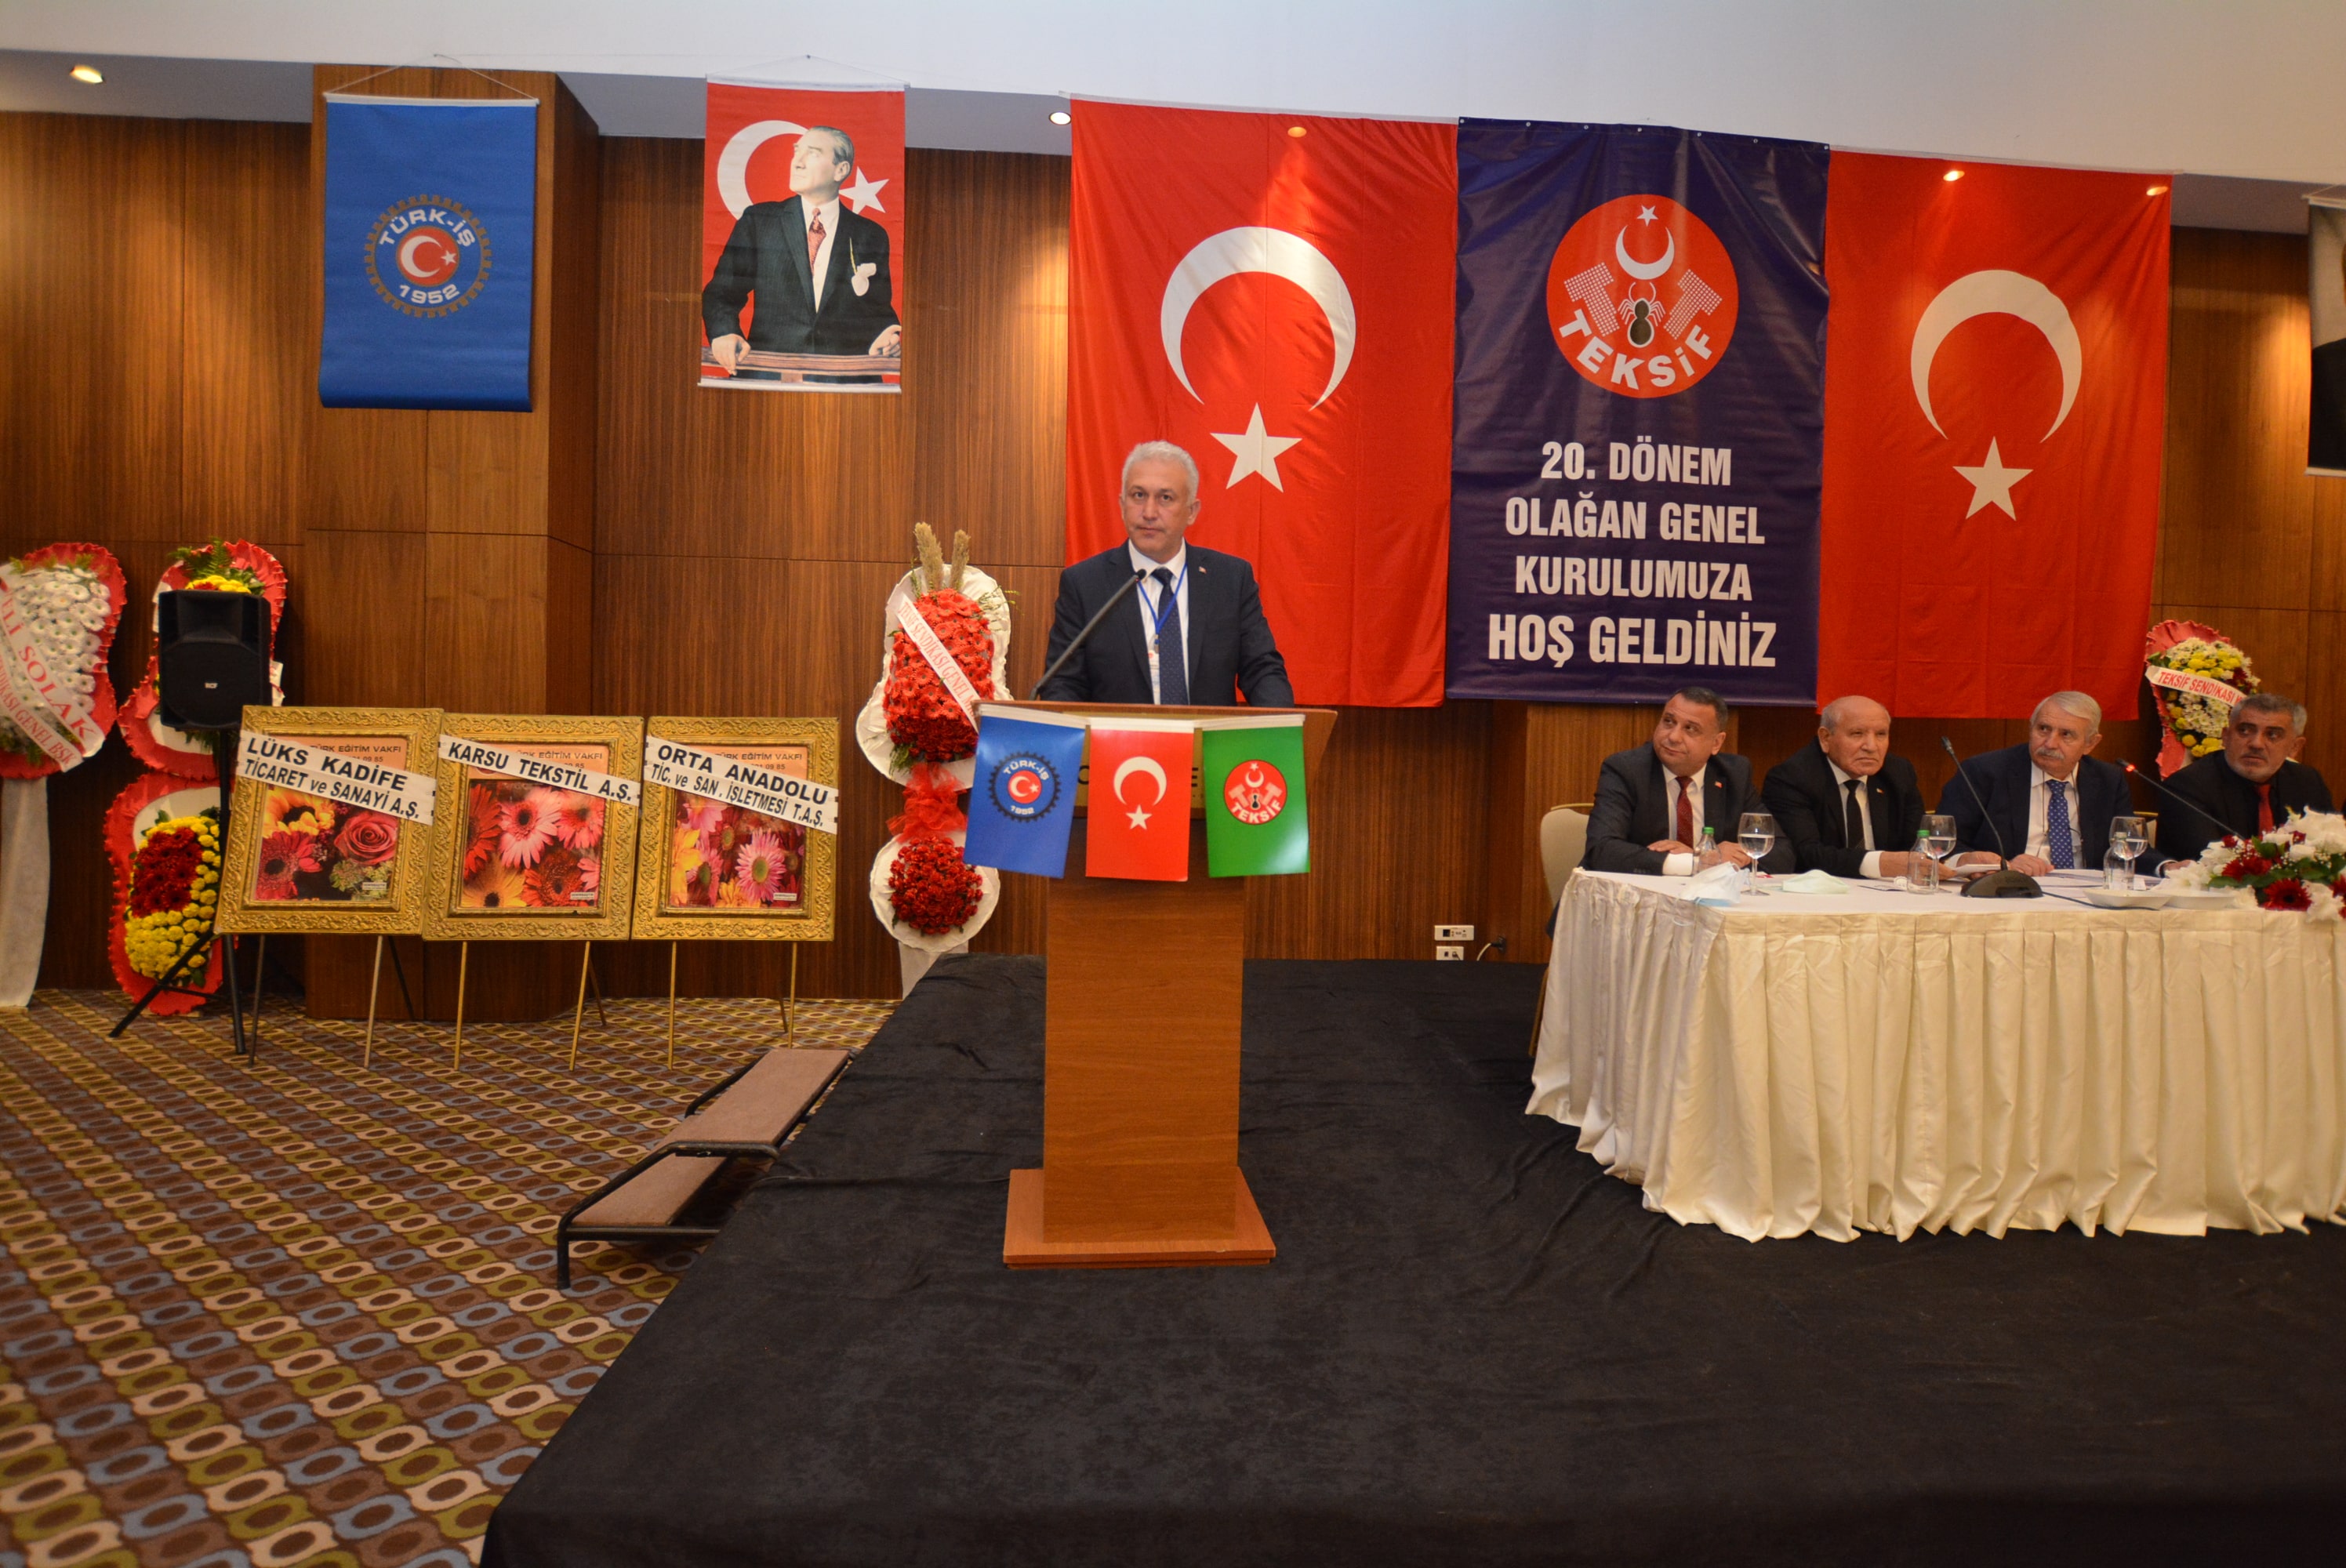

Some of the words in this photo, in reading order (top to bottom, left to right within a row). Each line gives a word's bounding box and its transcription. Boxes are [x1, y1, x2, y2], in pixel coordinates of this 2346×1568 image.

[379, 209, 476, 247] TÜRK-İŞ
[399, 283, 460, 304] 1952
[1559, 308, 1712, 390] TEKSİF
[1541, 441, 1596, 480] 20.
[1609, 435, 1731, 486] DÖNEM
[1505, 491, 1647, 539] OLAĞAN
[1659, 502, 1766, 544] GENEL
[1515, 555, 1752, 601] KURULUMUZA
[1488, 613, 1574, 668] HOŞ
[1589, 609, 1777, 667] GELDİNİZ
[19, 646, 97, 739] SOLAK
[942, 665, 970, 699] GENEL
[2158, 672, 2191, 688] TEKSİF
[2188, 678, 2235, 702] SENDİKASI
[16, 710, 53, 746] GENEL
[49, 741, 76, 765] BSK
[339, 744, 369, 753] EĞİTİM
[539, 750, 571, 759] EĞİTİM
[741, 752, 772, 760] EĞİTİM
[244, 759, 308, 789] TİCARET
[310, 779, 328, 794] ve
[330, 782, 389, 810] SANAYİ
[390, 799, 419, 819] A.Ş.
[247, 737, 309, 767] LÜKS
[321, 755, 408, 792] KADİFE
[448, 742, 509, 770] KARSU
[519, 759, 588, 790] TEKSTİL
[598, 780, 632, 802] A.Ş.
[658, 745, 714, 773] ORTA
[724, 764, 828, 805] ANADOLU
[651, 762, 671, 782] TİC.
[675, 773, 688, 788] ve
[726, 784, 789, 816] İŞLETMESİ
[792, 803, 823, 827] T.A.Ş.
